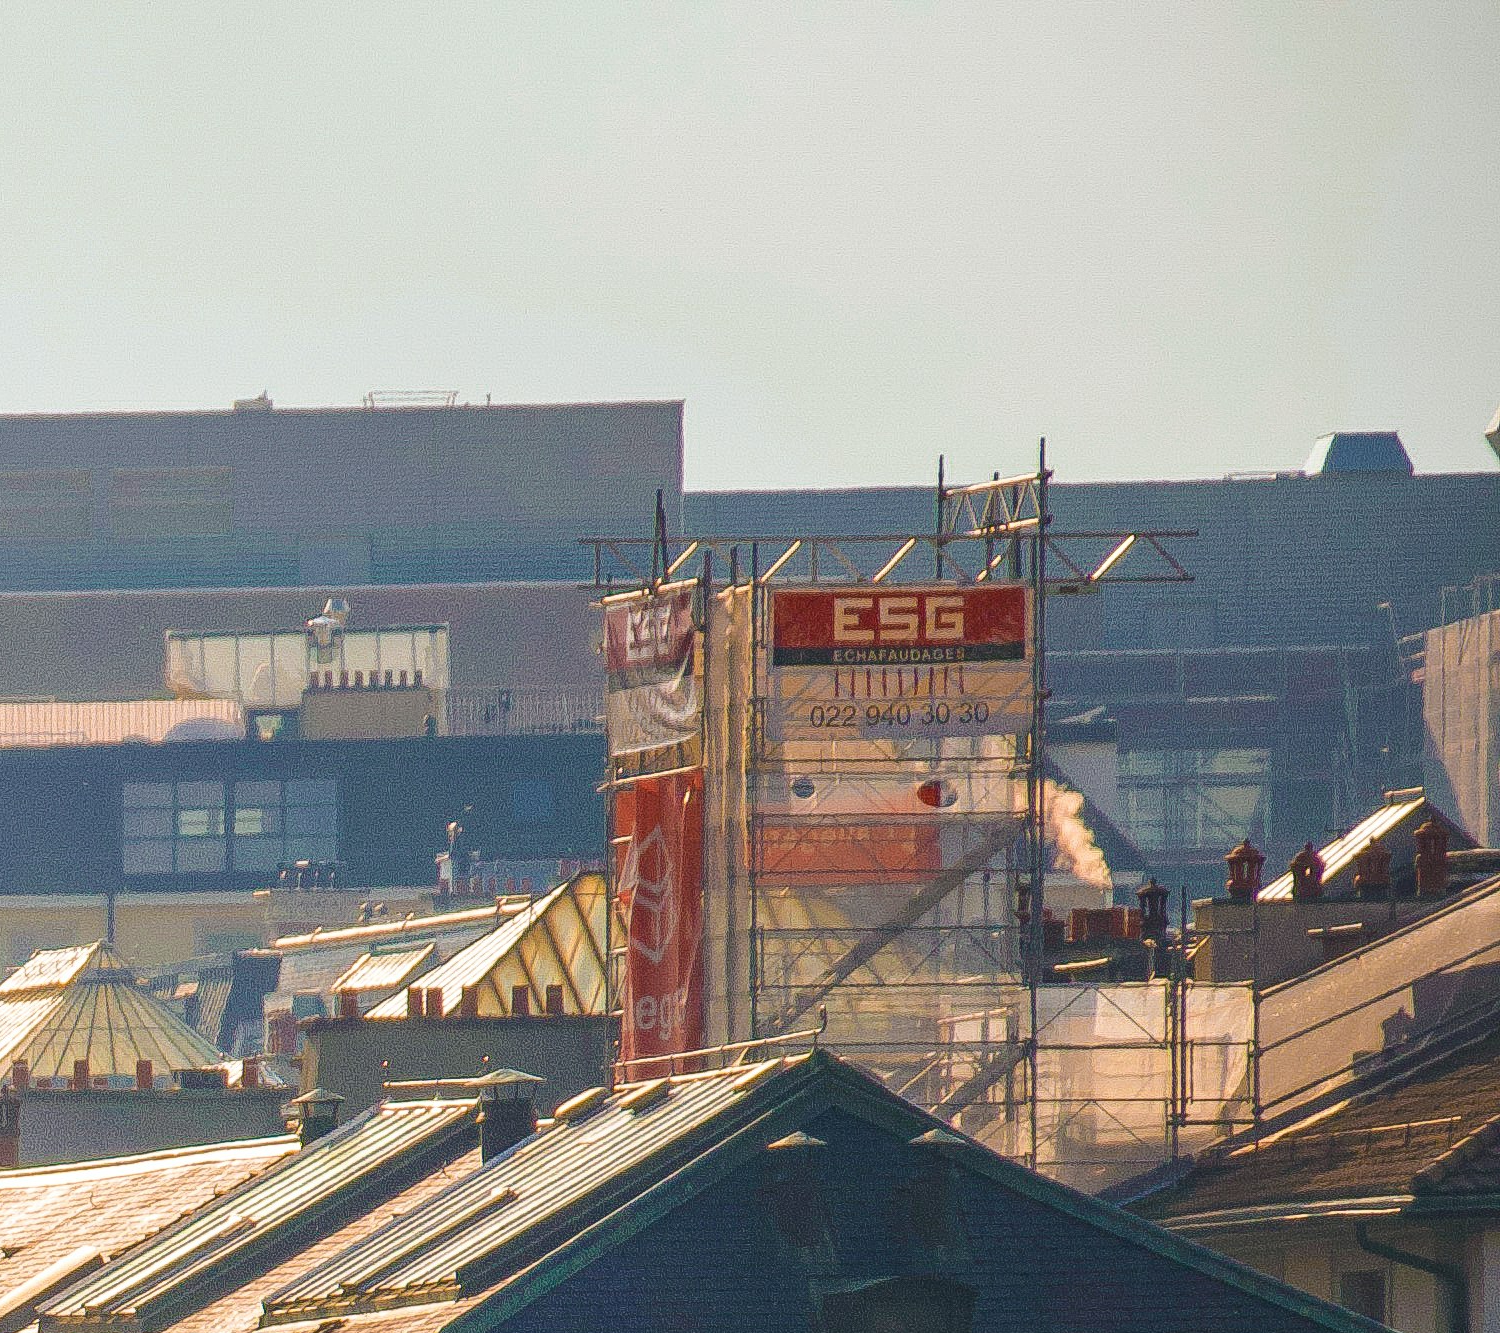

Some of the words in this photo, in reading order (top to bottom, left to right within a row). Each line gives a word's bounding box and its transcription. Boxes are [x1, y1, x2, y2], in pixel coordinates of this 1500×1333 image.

[833, 596, 965, 641] ESG
[809, 703, 856, 729] 022
[865, 702, 912, 728] 940
[922, 701, 951, 726] 30
[959, 701, 989, 725] 30
